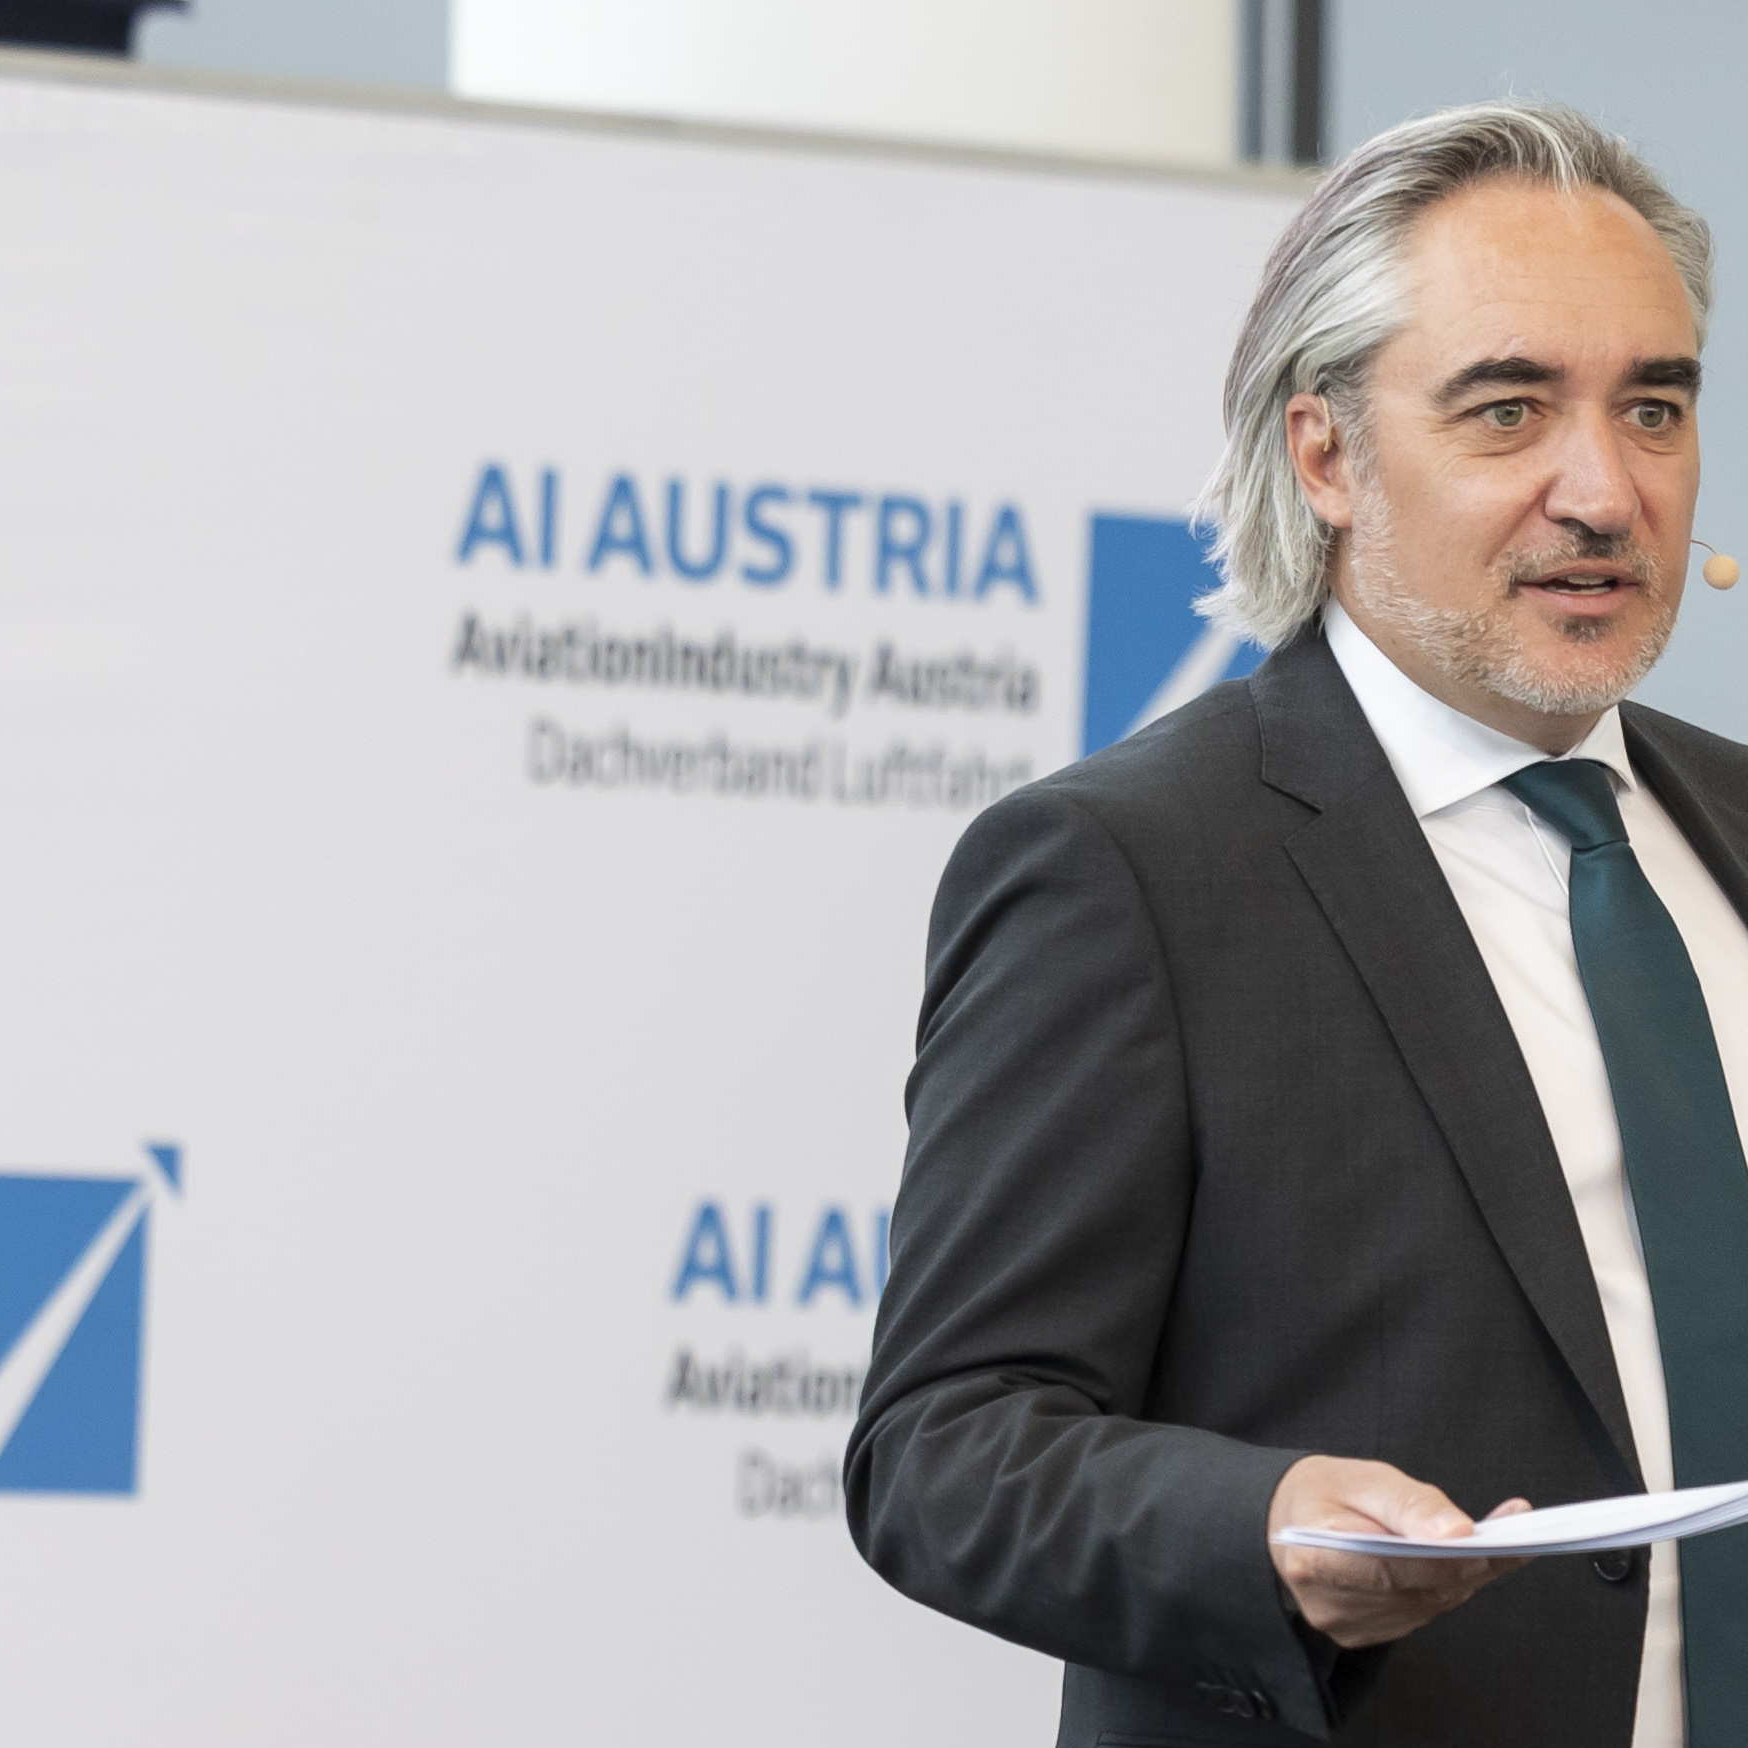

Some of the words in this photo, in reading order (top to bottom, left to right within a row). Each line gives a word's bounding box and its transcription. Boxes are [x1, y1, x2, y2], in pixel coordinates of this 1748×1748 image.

[455, 461, 561, 571] AI
[583, 470, 1041, 608] AUSTRIA
[451, 611, 854, 720] AviationIndustry
[865, 640, 1042, 718] Austria
[527, 715, 826, 804] Dachverband
[669, 1199, 775, 1306] AI
